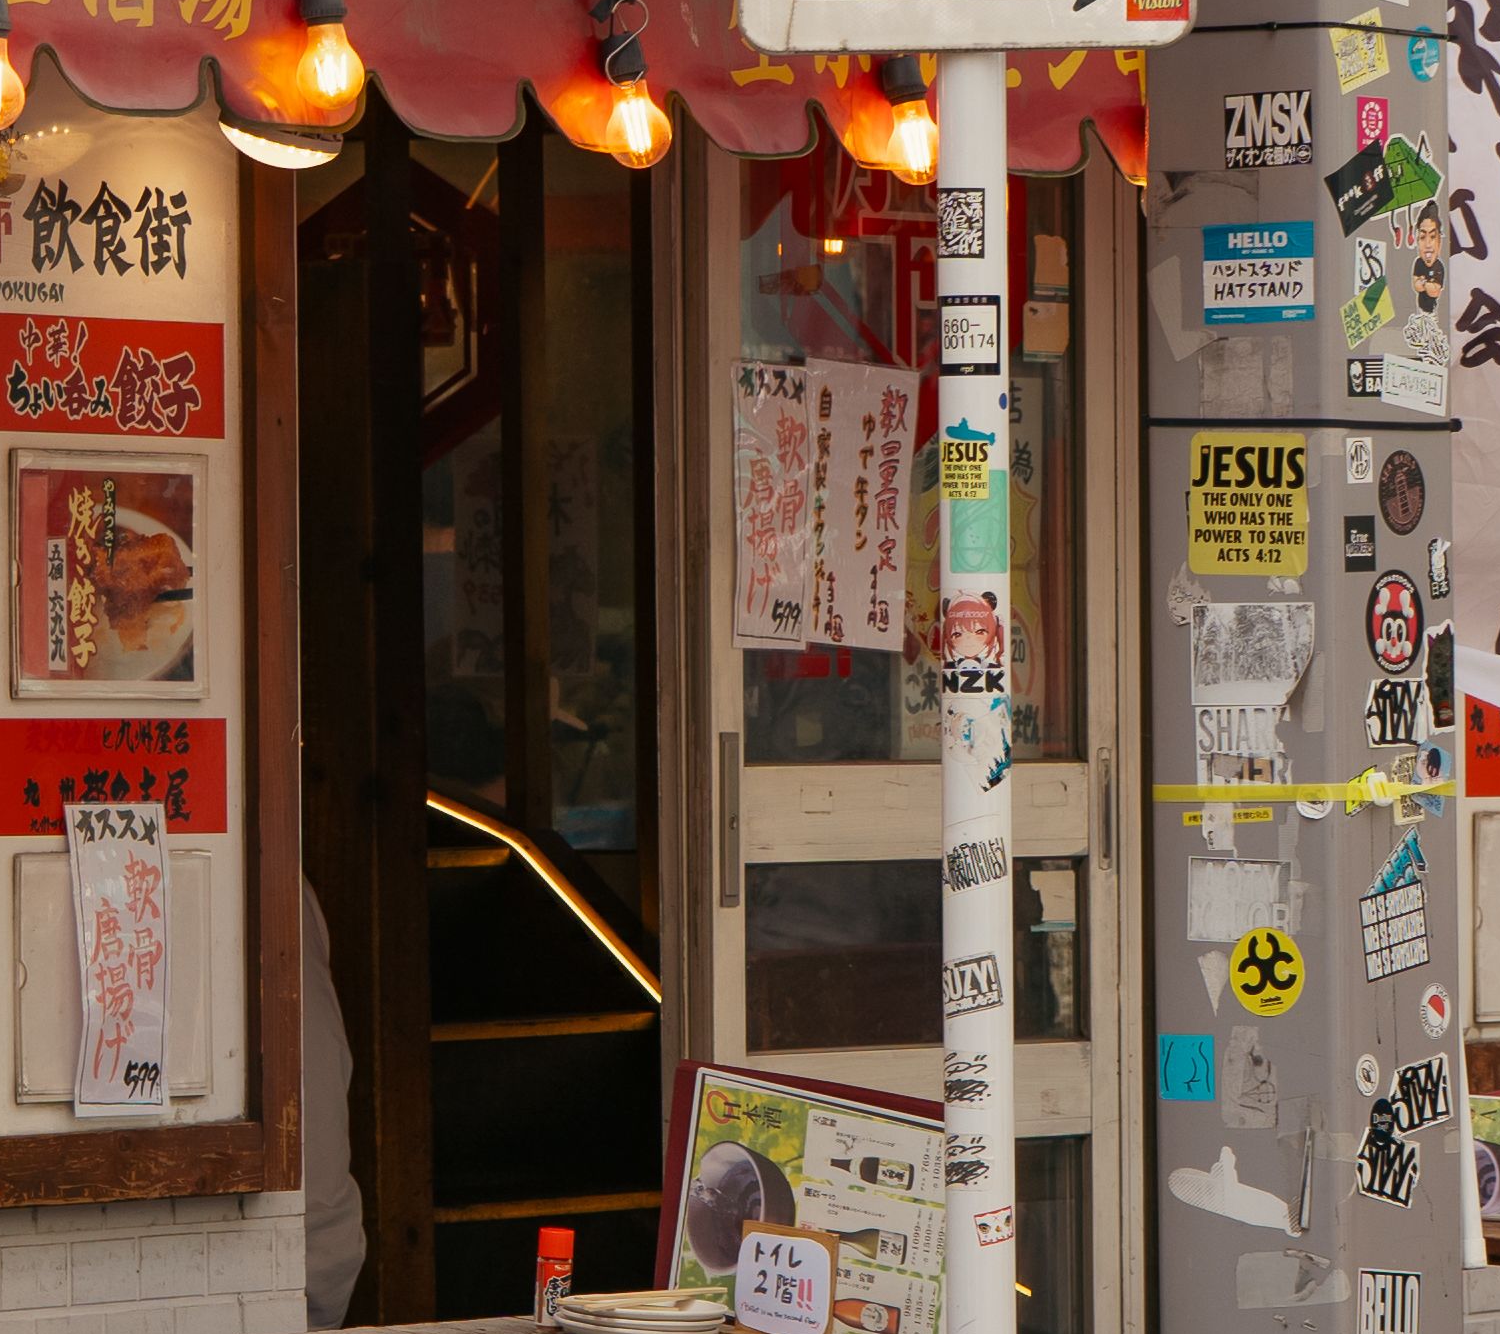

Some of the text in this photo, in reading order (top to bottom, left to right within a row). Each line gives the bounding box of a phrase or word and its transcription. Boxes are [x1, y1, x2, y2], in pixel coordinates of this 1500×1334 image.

[1225, 91, 1312, 149] ZMSK
[22, 177, 193, 280] 飲食街
[1228, 230, 1289, 250] HELLO
[1214, 281, 1304, 301] HATSTAND
[943, 317, 981, 335] 660-
[943, 333, 996, 351] 001174
[942, 442, 989, 463] JESUS
[1192, 445, 1306, 490] JESUS
[1202, 492, 1293, 508] THE ONLY ONE
[1204, 511, 1294, 526] WHO HAS THE
[1194, 528, 1305, 545] POWER TO SAVE!
[1217, 548, 1282, 563] ACTS 4:12
[942, 670, 1006, 694] NZK
[89, 896, 138, 1085] 唐揚げ
[754, 1240, 803, 1269] トイレ
